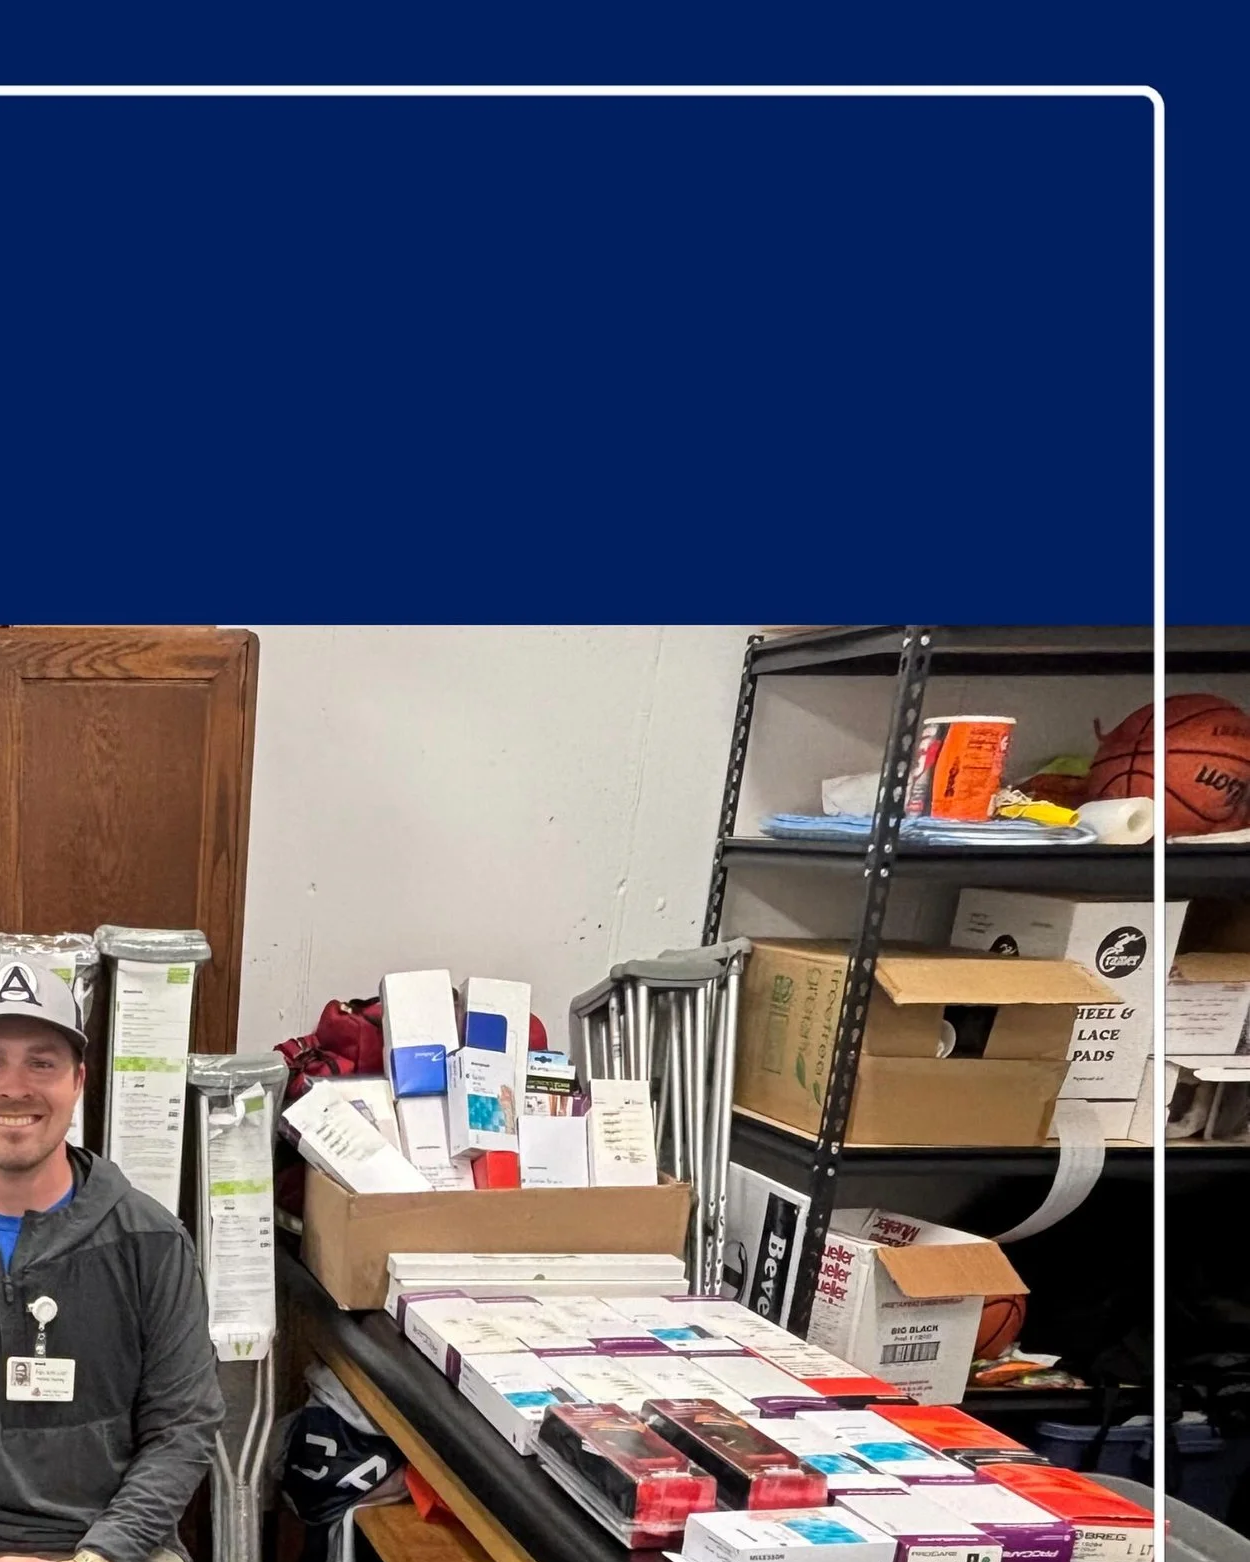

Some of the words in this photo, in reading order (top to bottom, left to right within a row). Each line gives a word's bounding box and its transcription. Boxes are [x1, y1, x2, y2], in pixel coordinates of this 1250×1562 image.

[1075, 1007, 1116, 1020] HEEL
[1120, 1007, 1136, 1020] &
[1077, 1029, 1121, 1041] LACE
[1071, 1050, 1115, 1062] PADS
[823, 1244, 855, 1265] ueller
[820, 1262, 851, 1282] ueller
[817, 1280, 848, 1300] ueller
[891, 1326, 907, 1336] BIG
[909, 1324, 939, 1334] BLACK
[1085, 1532, 1127, 1542] BREG
